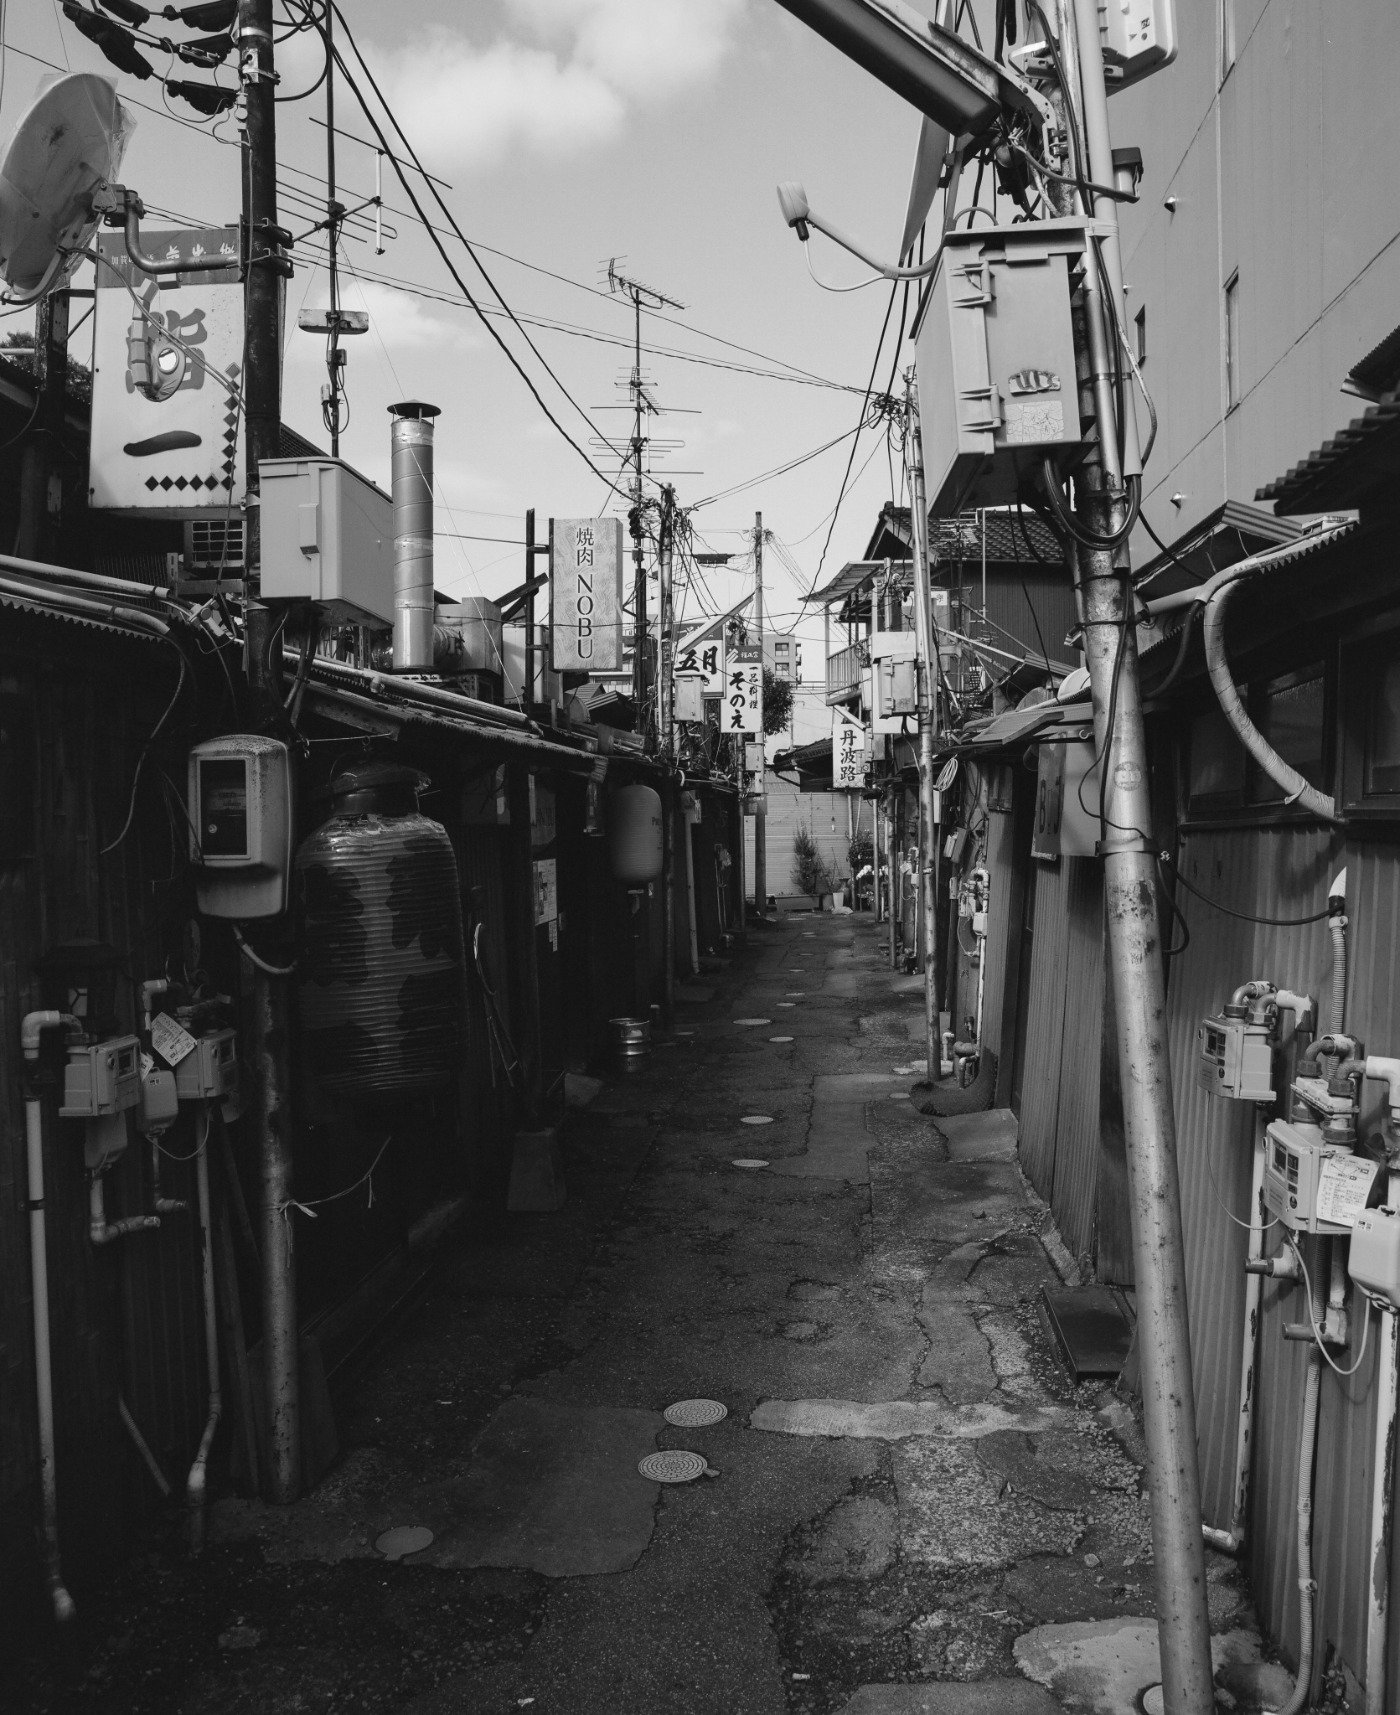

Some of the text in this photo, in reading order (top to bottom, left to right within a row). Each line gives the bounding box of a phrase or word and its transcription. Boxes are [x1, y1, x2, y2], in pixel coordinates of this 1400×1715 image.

[576, 527, 595, 659] 焼肉 NOBU
[674, 645, 718, 675] 五月
[729, 671, 746, 729] そのえ
[839, 729, 857, 782] 丹波路
